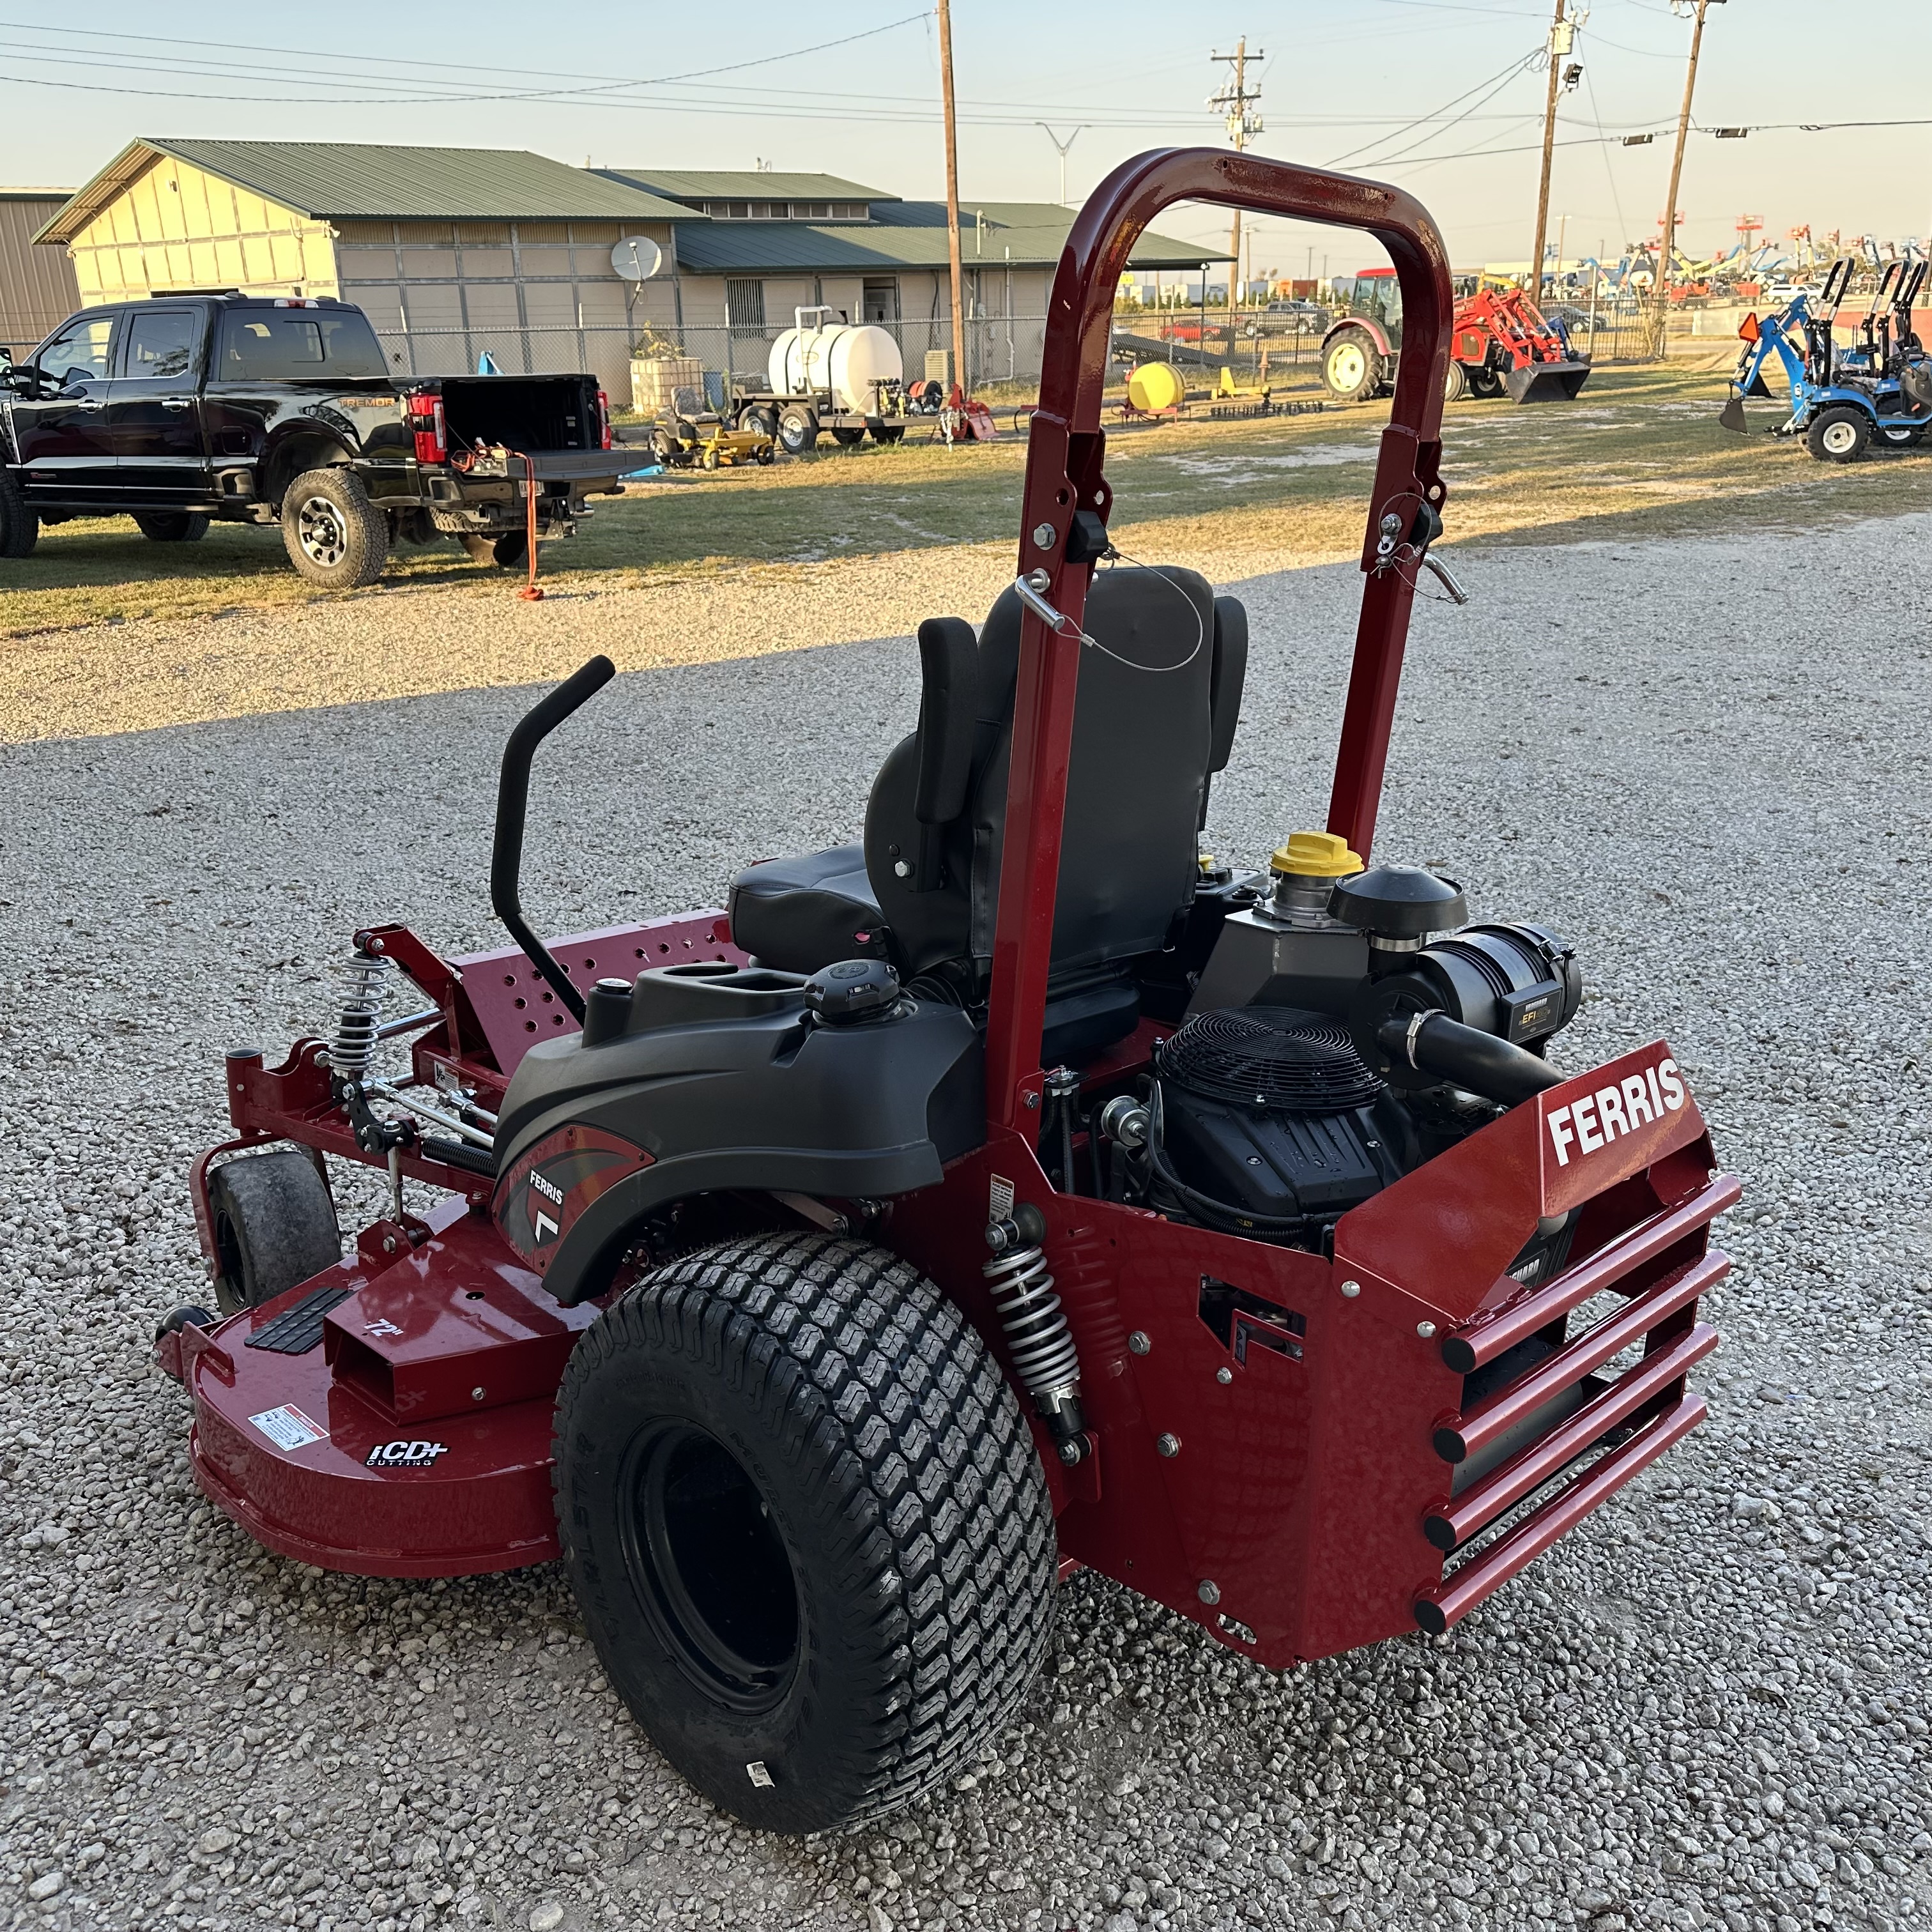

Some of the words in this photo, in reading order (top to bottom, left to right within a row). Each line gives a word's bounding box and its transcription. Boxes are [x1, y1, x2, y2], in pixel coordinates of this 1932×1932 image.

[338, 397, 395, 407] TREMOR
[1547, 1059, 1685, 1167] FERRIS
[530, 1170, 563, 1205] FERRIS
[364, 1319, 404, 1337] 72"
